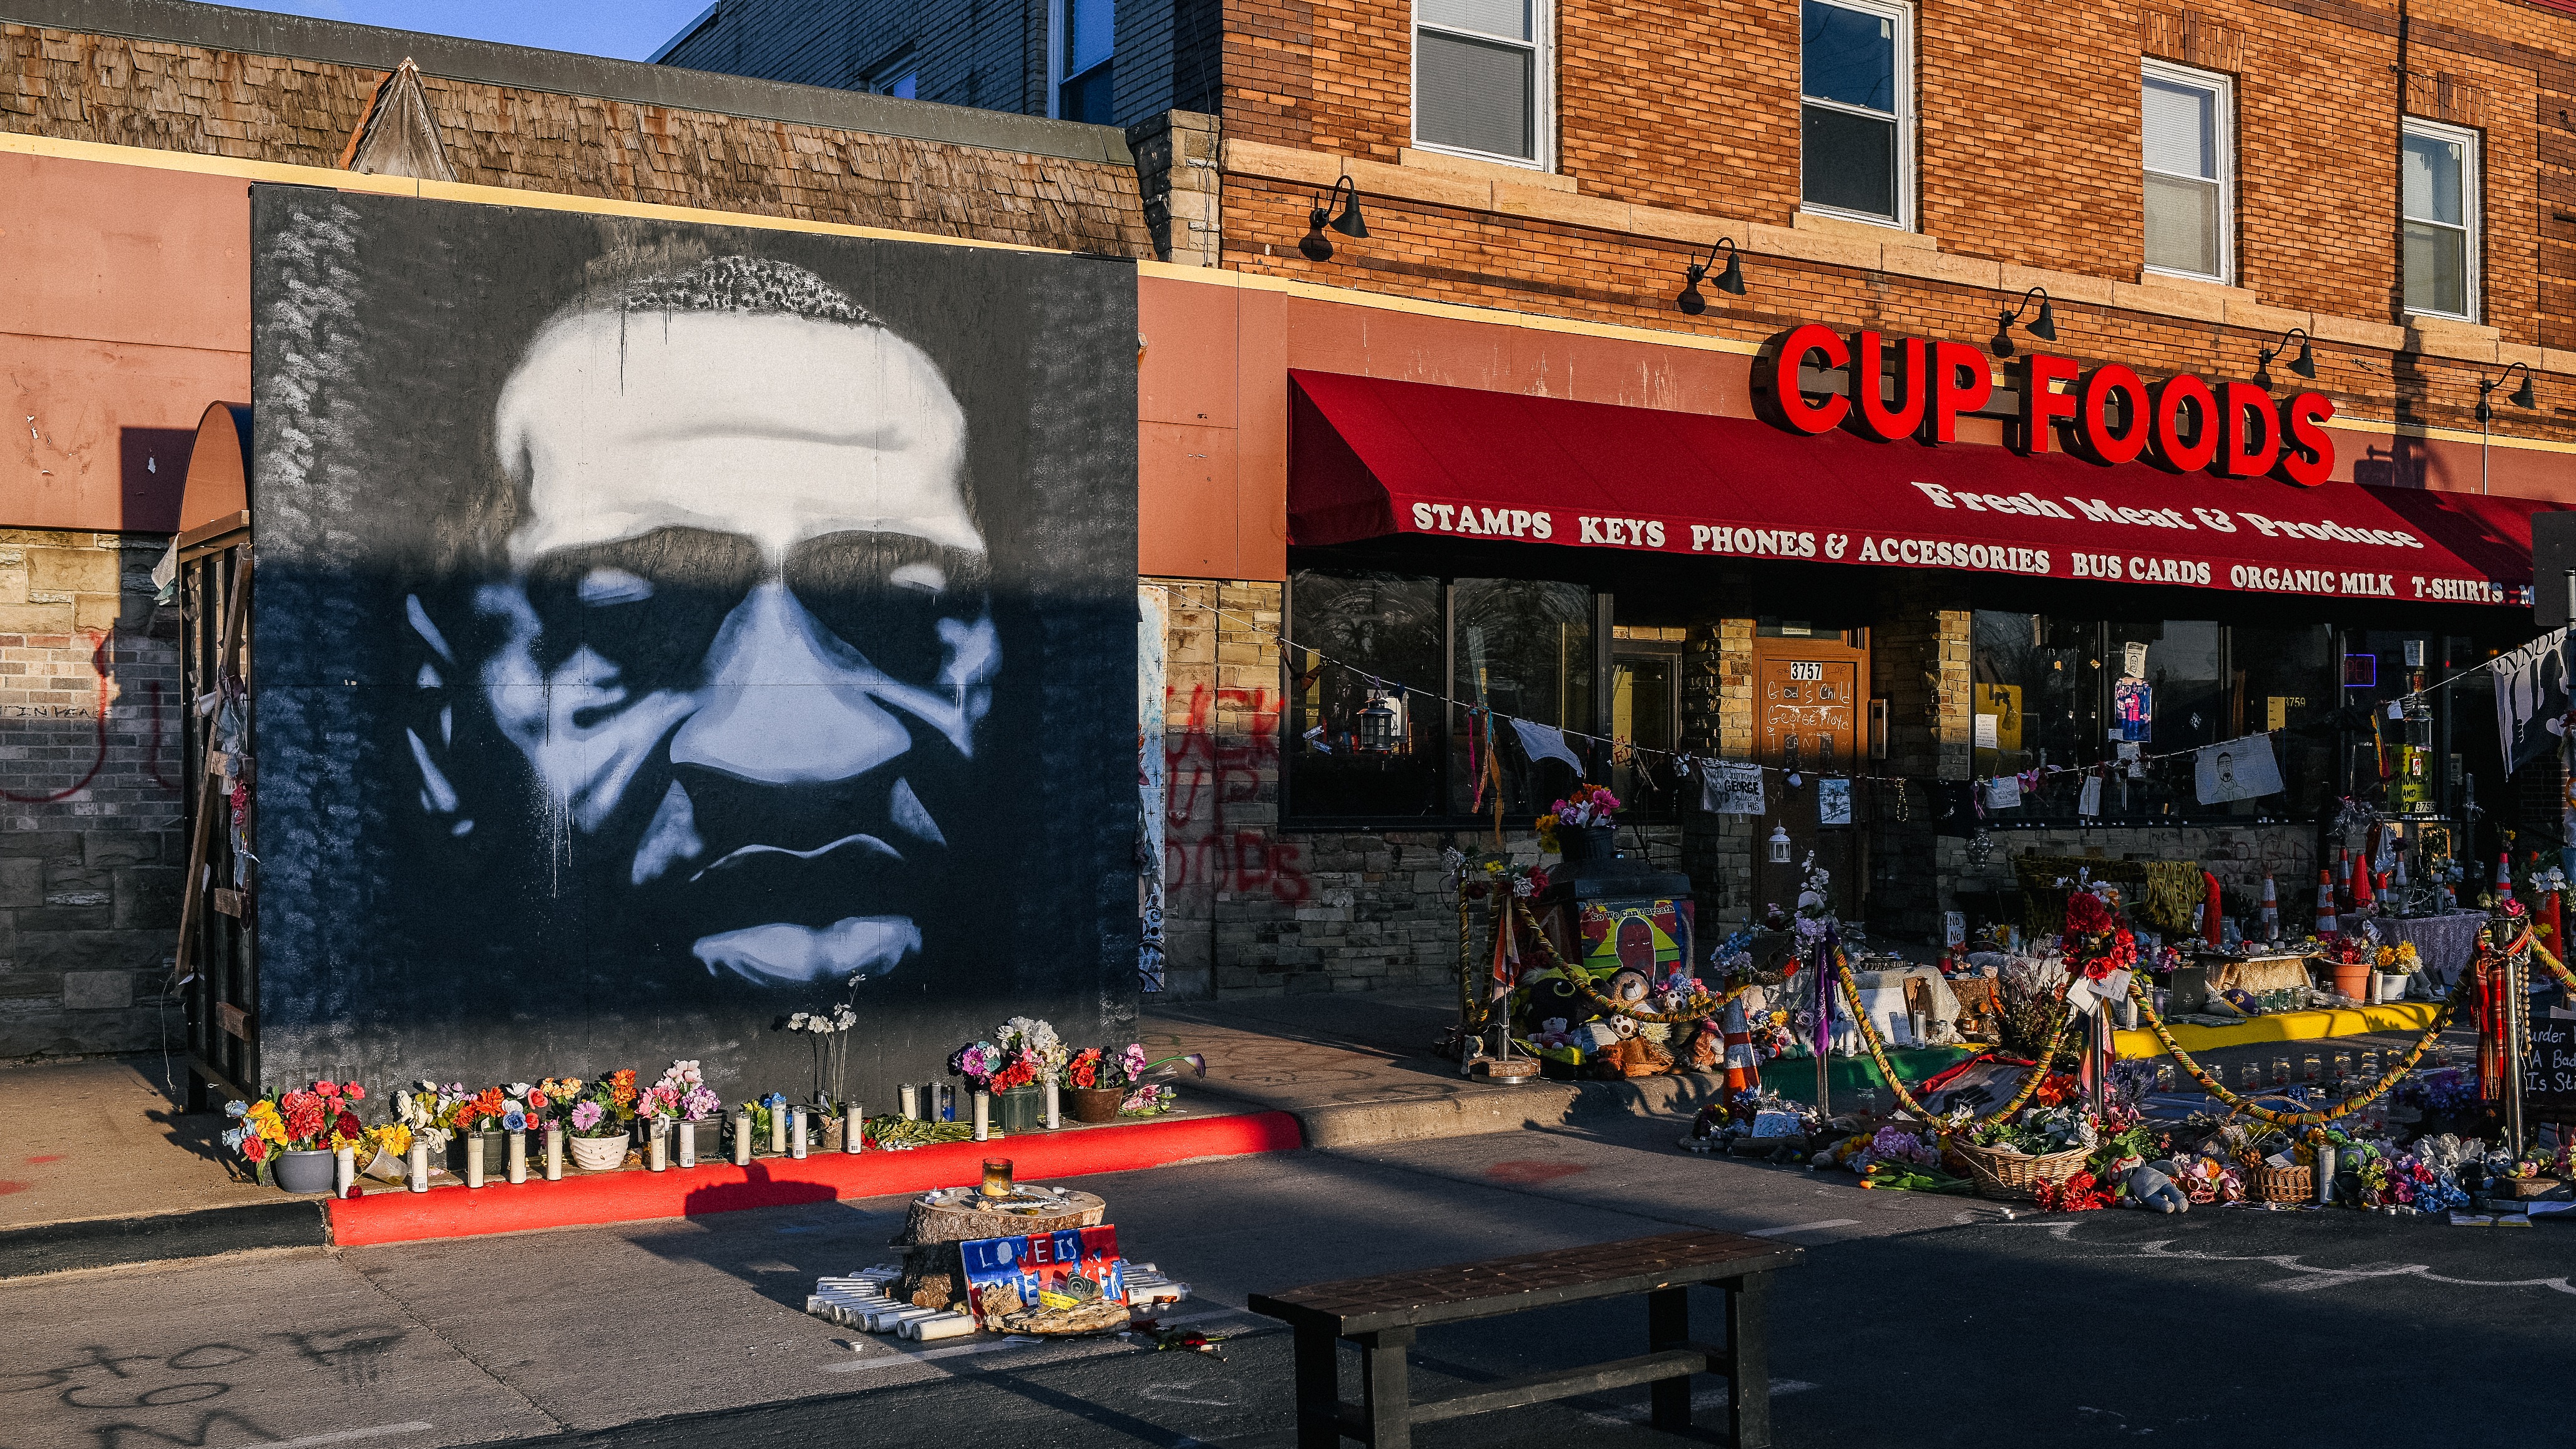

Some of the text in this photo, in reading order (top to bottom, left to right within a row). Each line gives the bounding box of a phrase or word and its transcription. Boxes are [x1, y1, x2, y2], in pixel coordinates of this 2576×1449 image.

[1777, 323, 2336, 487] CUP FOODS
[1911, 481, 2424, 549] Fresh Meat & Produce
[1412, 502, 1553, 539] STAMPS
[1578, 516, 1666, 547] KEYS
[1690, 524, 1816, 557] PHONES
[1825, 534, 1848, 559] &
[1858, 537, 2051, 574] ACCESSORIES
[2072, 552, 2122, 579] BUS
[2129, 558, 2211, 585] CARDS
[2230, 564, 2336, 594] ORGANIC
[2341, 572, 2396, 597] MILK
[2411, 576, 2504, 604] T-SHIRTS
[1792, 663, 1822, 680] 3757
[2345, 659, 2373, 682] PEN
[2285, 696, 2306, 707] 3759
[1724, 779, 1760, 796] GEORGE
[2403, 789, 2416, 799] AND
[1748, 802, 1759, 811] HIS
[2416, 803, 2436, 811] 3759
[1591, 905, 1675, 922] So We Can't Breath
[2529, 1024, 2566, 1043] urder
[2532, 1050, 2542, 1068] A
[2526, 1071, 2547, 1091] Is
[980, 1237, 1076, 1268] LOVE IS
